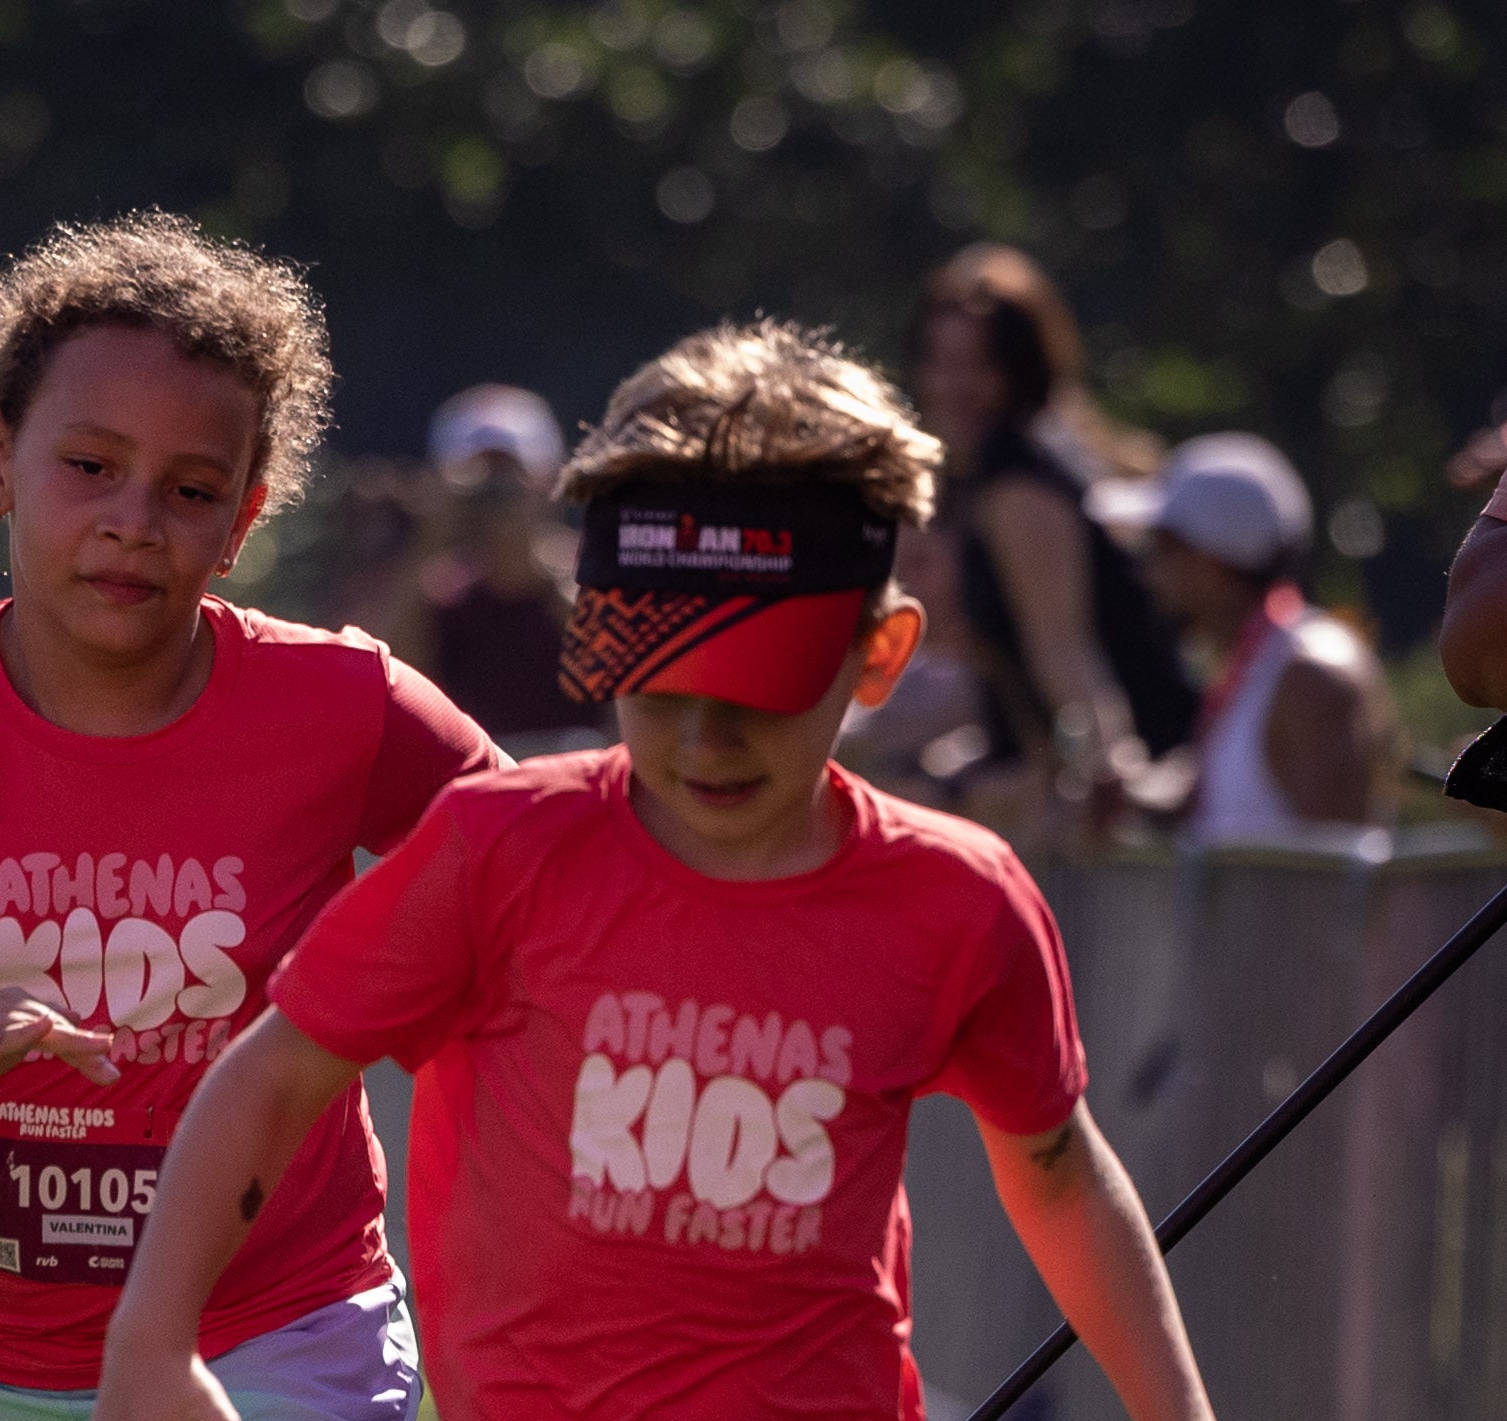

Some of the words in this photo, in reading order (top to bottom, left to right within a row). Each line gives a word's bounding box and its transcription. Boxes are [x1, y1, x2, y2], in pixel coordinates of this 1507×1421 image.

[93, 1019, 232, 1064] ASTER
[583, 992, 853, 1086] ATHENAS
[19, 1124, 44, 1137] RUN
[46, 1125, 87, 1139] FASTER
[73, 1107, 115, 1127] KIDS
[569, 1052, 846, 1211] KIDS
[10, 1164, 158, 1214] 10105
[50, 1222, 127, 1236] VALENTINA
[568, 1174, 655, 1236] RUN
[664, 1192, 823, 1254] FASTER
[36, 1256, 58, 1267] rvb
